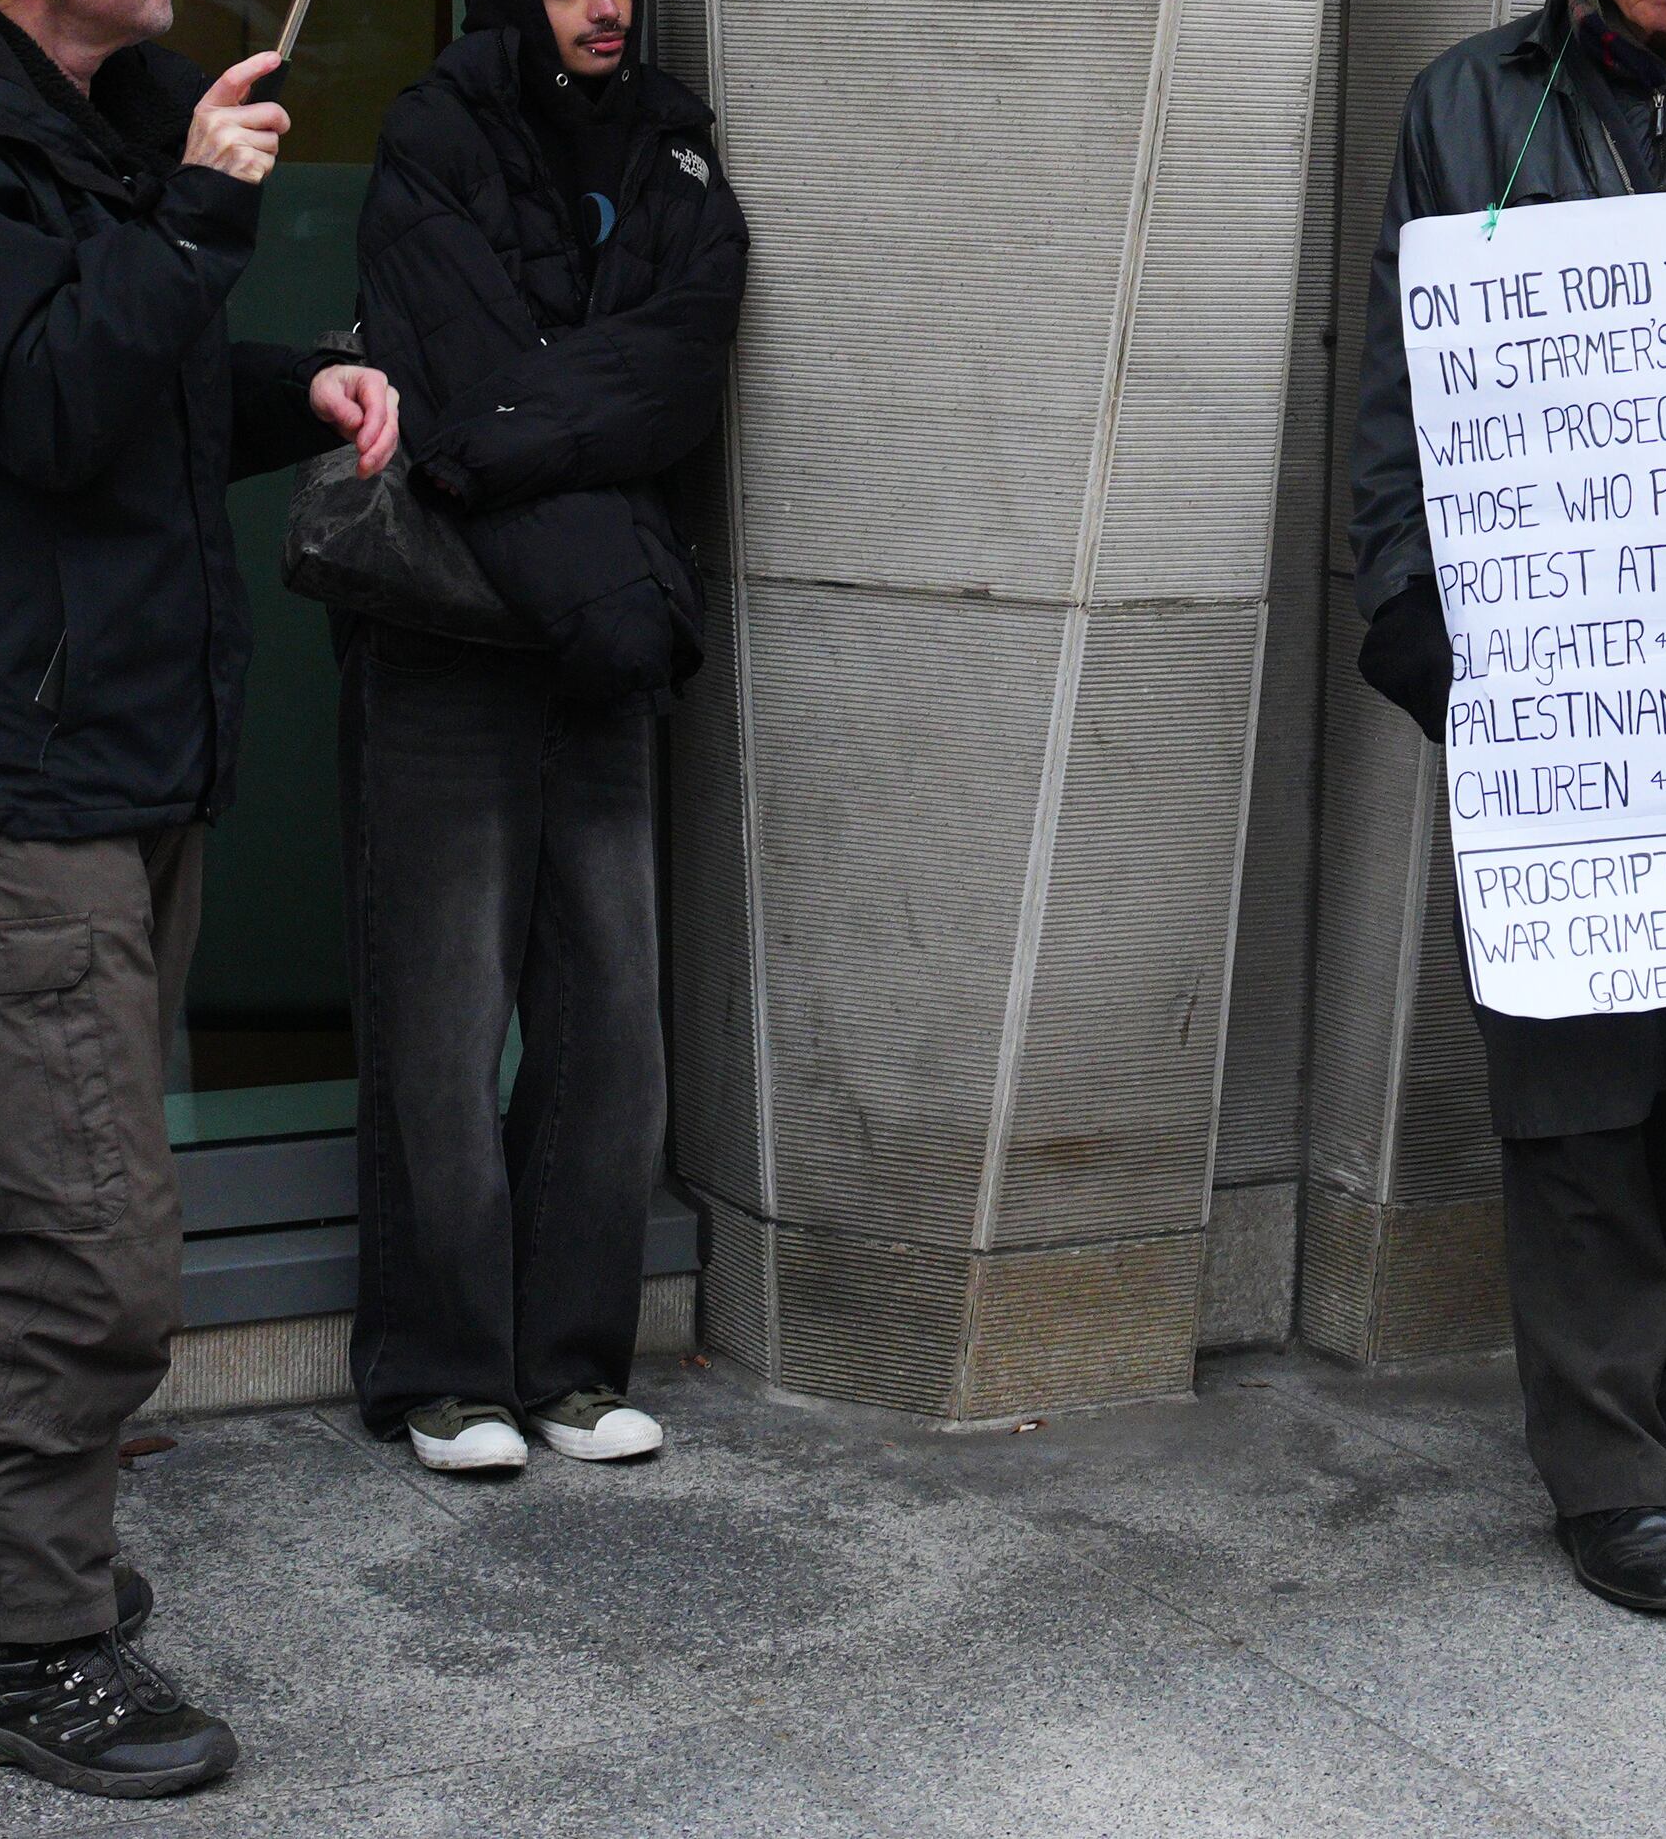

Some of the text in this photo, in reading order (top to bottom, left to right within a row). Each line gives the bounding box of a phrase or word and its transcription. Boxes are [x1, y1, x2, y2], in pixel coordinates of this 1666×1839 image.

[1409, 284, 1459, 330] ON
[1470, 272, 1547, 322] THE
[1559, 262, 1651, 313] ROAD
[1440, 347, 1477, 395] IN
[1419, 413, 1526, 467] WHICH
[1428, 485, 1539, 539] THOSE
[1557, 474, 1631, 522] WHO
[1439, 549, 1595, 611] PROTEST
[1450, 619, 1645, 685] SLAUGHTER
[1455, 760, 1628, 819] CHILDREN
[1472, 922, 1554, 963] WAR
